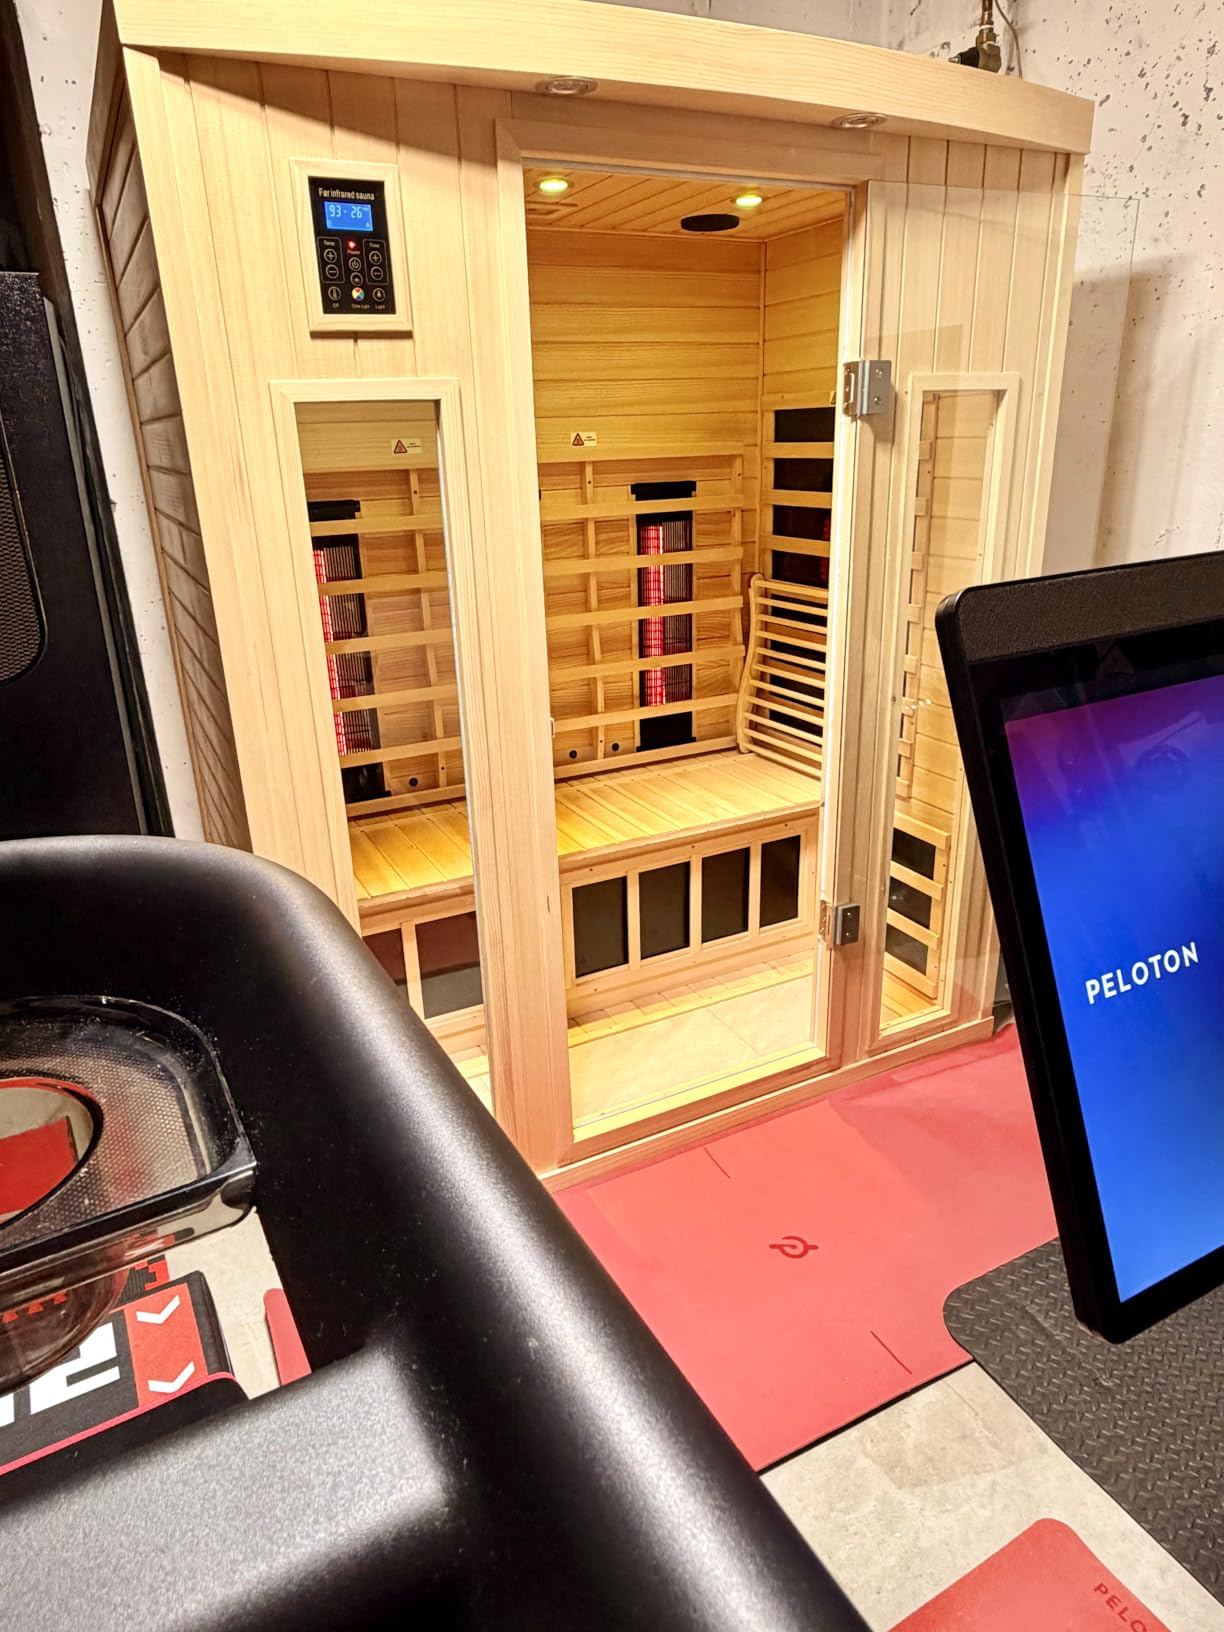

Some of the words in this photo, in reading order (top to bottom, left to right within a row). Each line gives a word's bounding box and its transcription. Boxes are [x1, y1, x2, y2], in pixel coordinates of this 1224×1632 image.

[318, 187, 330, 197] Far
[330, 189, 355, 199] infrared
[355, 192, 375, 201] sauna
[329, 204, 342, 217] 93
[350, 206, 363, 218] 26
[1085, 941, 1199, 1005] PELOTON
